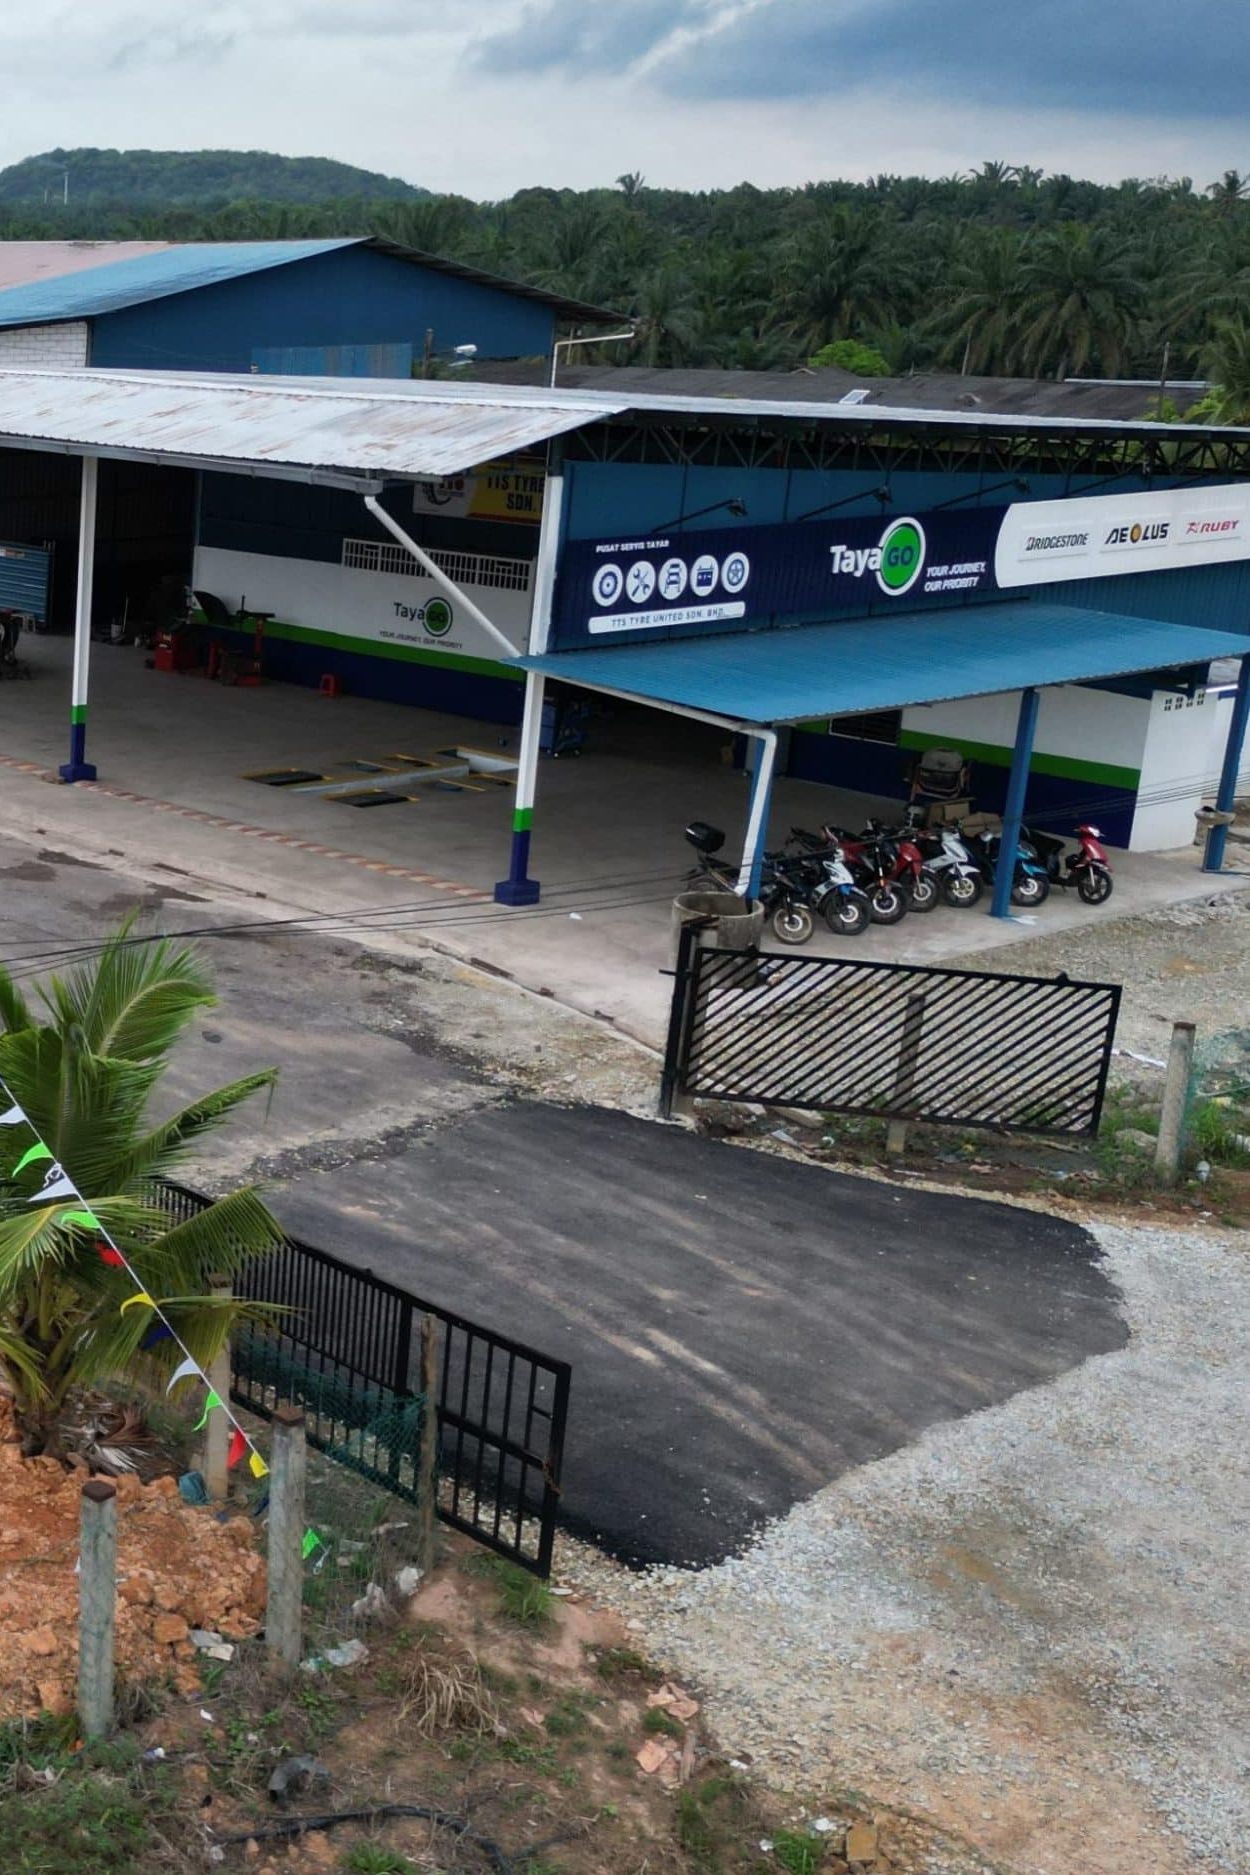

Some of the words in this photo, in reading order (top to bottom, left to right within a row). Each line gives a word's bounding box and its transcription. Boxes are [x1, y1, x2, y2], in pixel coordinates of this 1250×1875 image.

[1104, 522, 1171, 545] AEOLUS
[1199, 519, 1240, 534] RUBY
[595, 543, 620, 553] PUSAT
[620, 541, 645, 552] SERVIS
[646, 539, 670, 549] TAYAR
[1025, 532, 1090, 551] BRIDGESTONE
[926, 564, 950, 578] YOUR
[924, 580, 943, 593] OUR
[941, 576, 980, 591] PRIORITY
[611, 618, 627, 628] TTS
[629, 615, 651, 626] TYRE
[653, 611, 683, 624] UNITED
